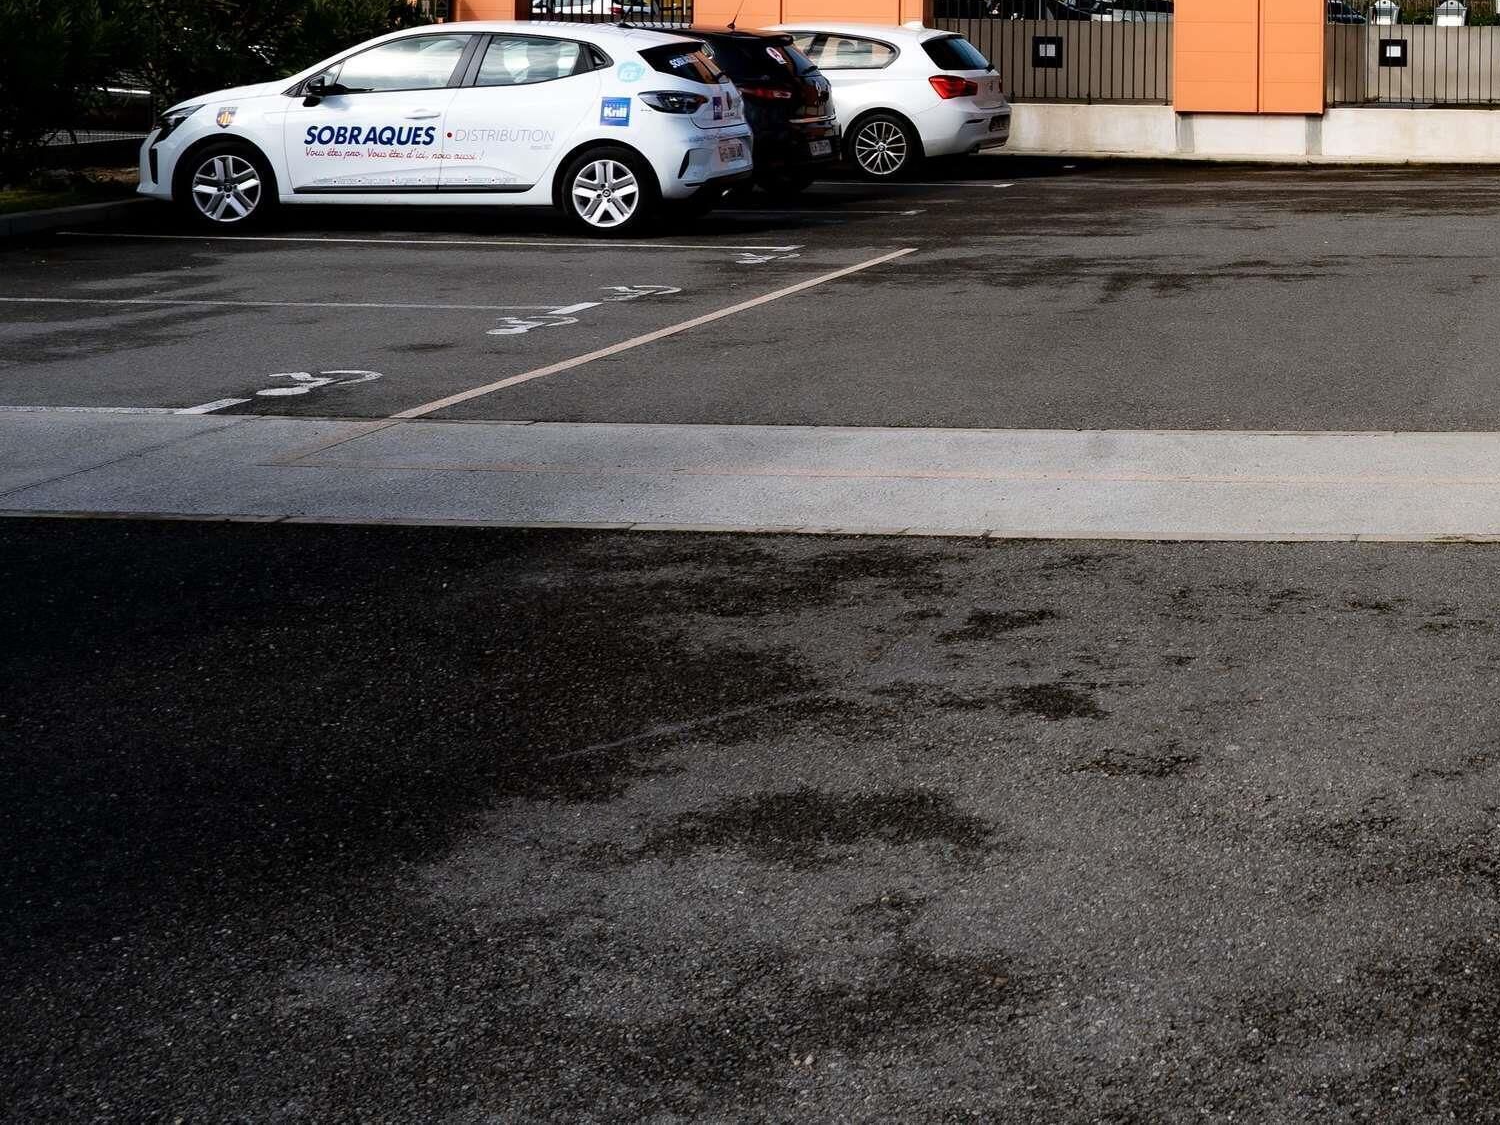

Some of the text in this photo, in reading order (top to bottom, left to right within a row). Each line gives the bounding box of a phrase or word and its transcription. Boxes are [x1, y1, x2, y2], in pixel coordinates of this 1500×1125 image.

[304, 125, 555, 146] SOBRAQUES DISTRIBUTION
[305, 147, 325, 157] Vous
[327, 149, 342, 157] êtes
[367, 148, 387, 158] Vous
[389, 150, 405, 158] êtes
